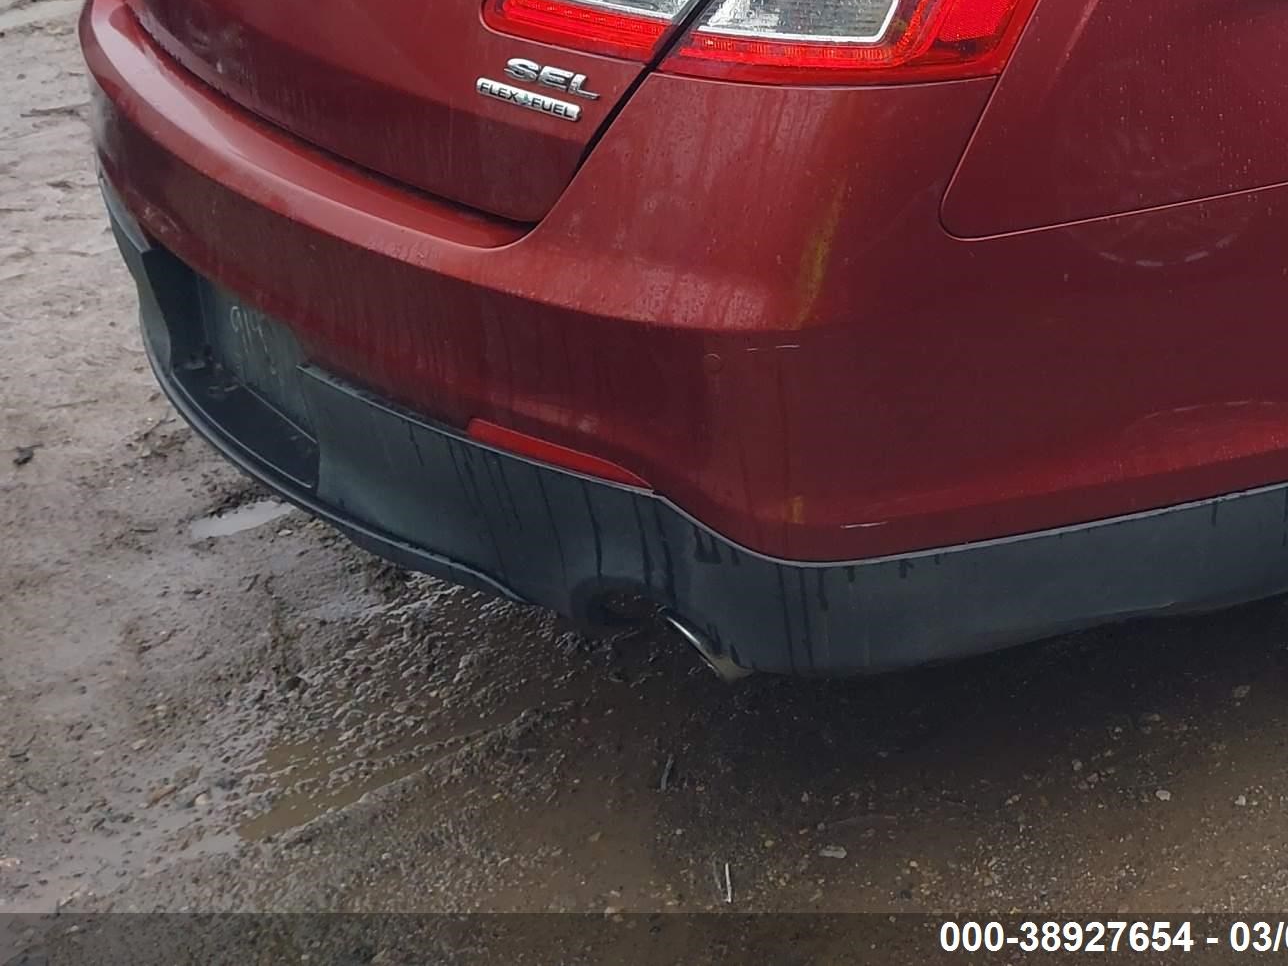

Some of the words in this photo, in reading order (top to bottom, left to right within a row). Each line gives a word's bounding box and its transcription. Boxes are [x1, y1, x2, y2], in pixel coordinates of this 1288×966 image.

[504, 58, 601, 100] SEL
[480, 82, 519, 102] FLEX
[531, 98, 575, 118] FUEL
